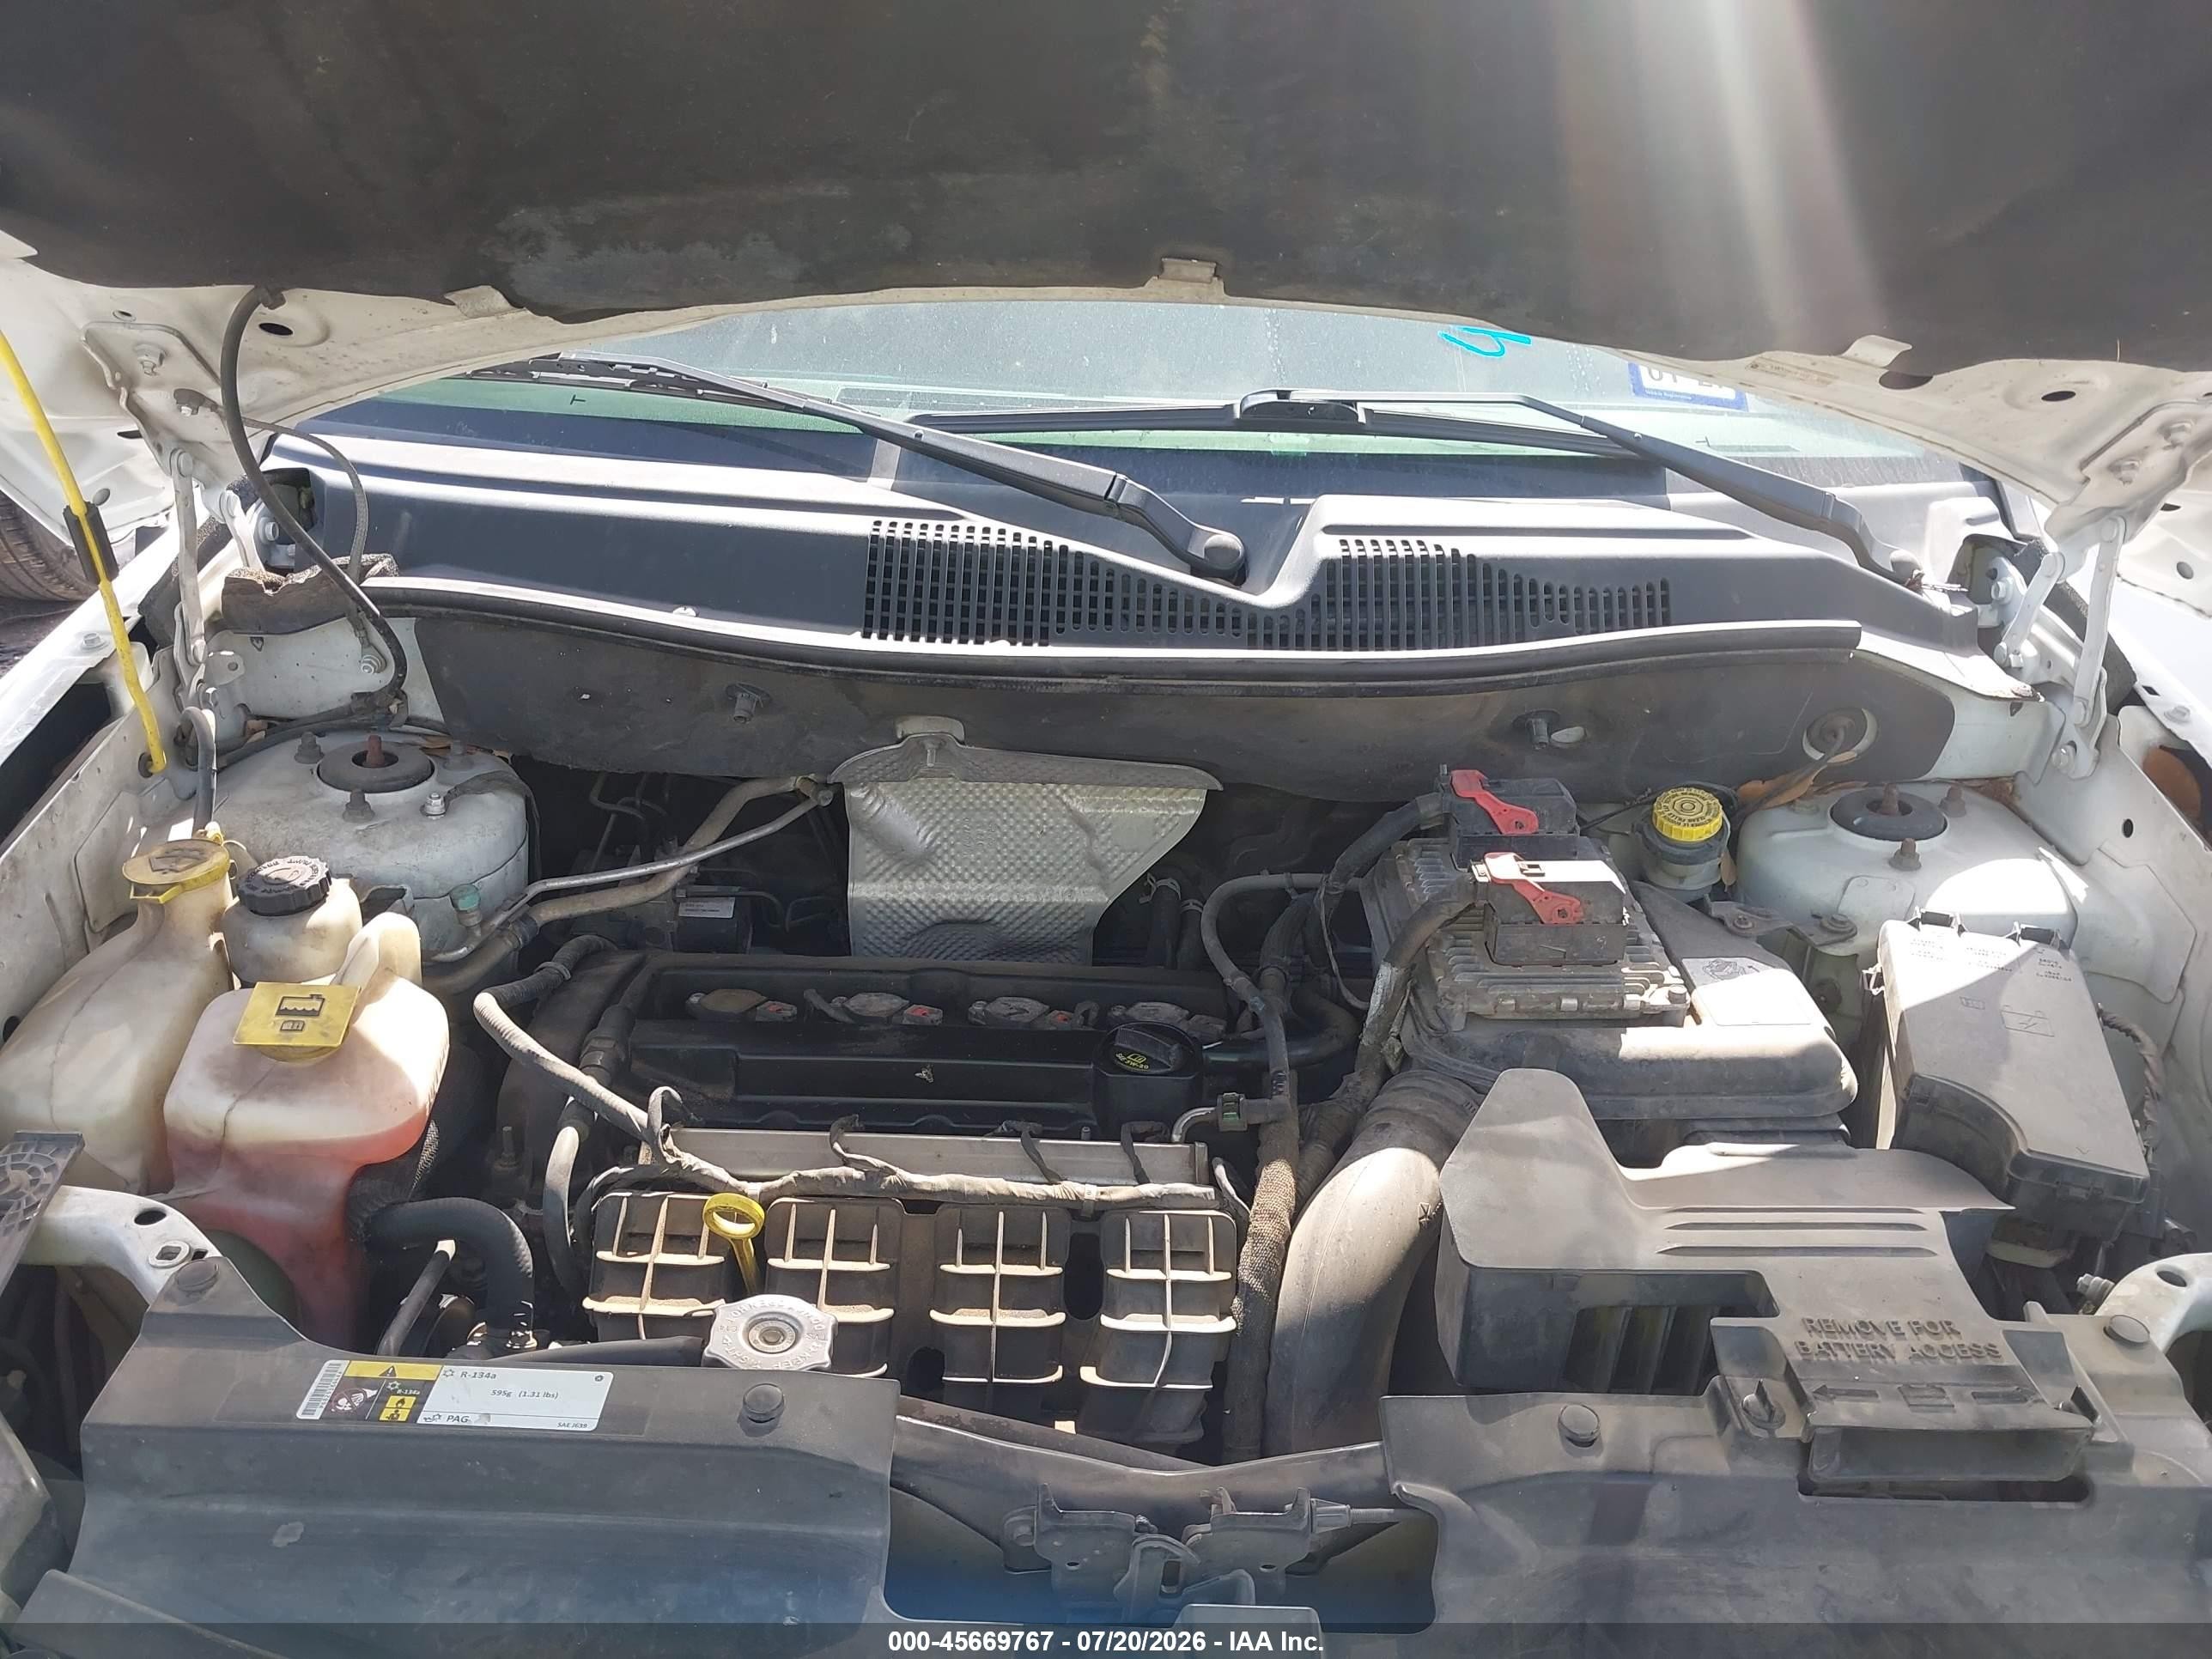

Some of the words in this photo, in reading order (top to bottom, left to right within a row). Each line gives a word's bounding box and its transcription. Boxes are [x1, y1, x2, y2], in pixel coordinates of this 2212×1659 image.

[1802, 1318, 1906, 1338] REMOVE
[1907, 1320, 1962, 1338] FOR
[1794, 1340, 1896, 1360] BATTERY
[1908, 1343, 2003, 1361] ACCESS
[459, 1371, 497, 1380] R-134a
[490, 1389, 513, 1398] 595g
[542, 1390, 559, 1400] lbs)
